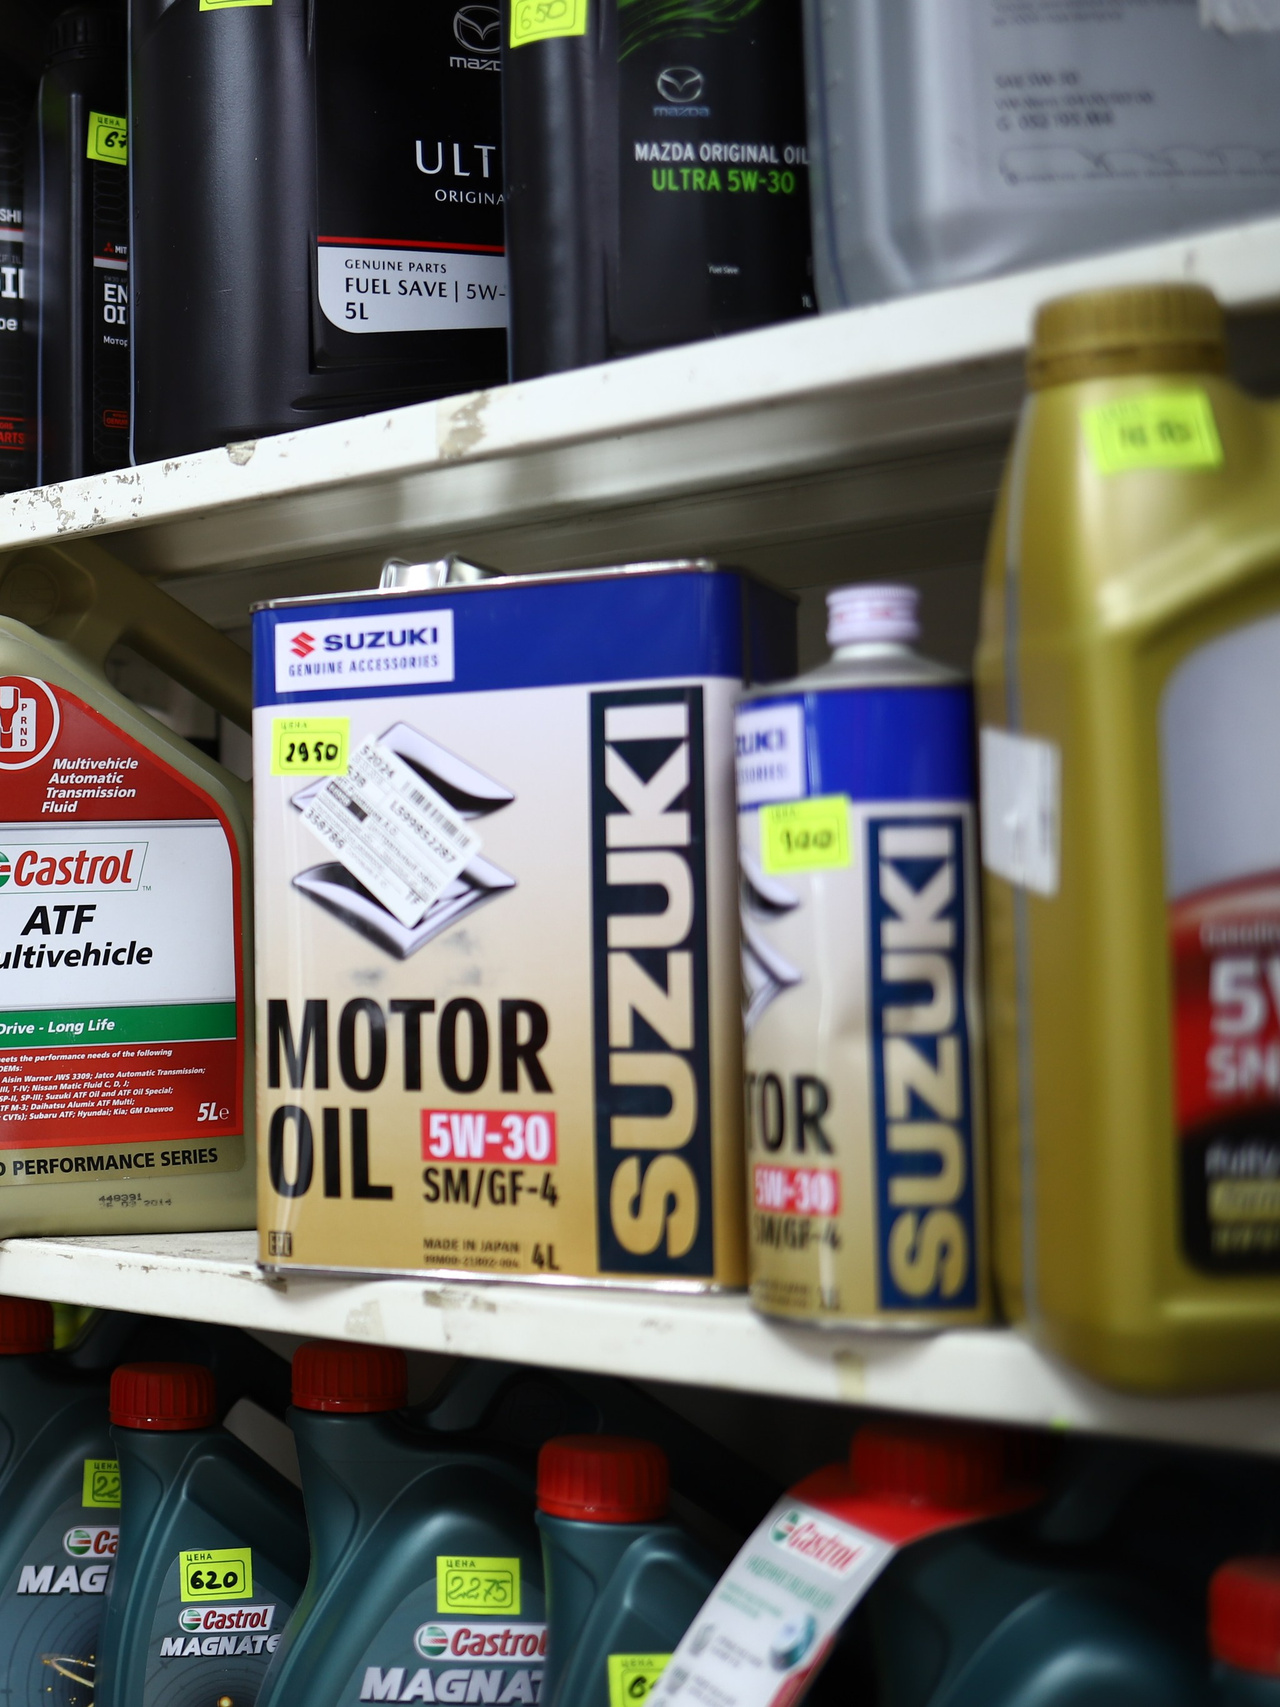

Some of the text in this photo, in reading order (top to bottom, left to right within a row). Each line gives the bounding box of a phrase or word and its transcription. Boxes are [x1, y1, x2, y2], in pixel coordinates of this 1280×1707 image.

[521, 0, 567, 30] 650
[98, 117, 120, 126] ЦЕНА
[415, 140, 496, 178] ULT
[634, 142, 810, 165] MAZDA ORIGINAL OIL
[651, 168, 795, 194] ULTRA 5W-30
[344, 259, 447, 274] GENUINE PARTS
[345, 277, 391, 296] FUEL
[398, 279, 448, 298] SAVE
[345, 302, 369, 320] 5L
[323, 627, 438, 651] SUZUKI
[288, 654, 439, 677] GENUINE ACCESSORIES
[53, 757, 138, 769] Multivehicle
[48, 772, 123, 784] Automatic
[46, 787, 136, 798] Transmission
[41, 801, 77, 813] Fluid
[14, 849, 134, 887] Castrol
[20, 904, 97, 936] ATF
[604, 702, 699, 1260] SUZUKI
[48, 1021, 84, 1035] Long
[88, 1019, 115, 1031] Life
[34, 1053, 85, 1063] performance
[87, 1051, 110, 1059] needs
[112, 1050, 120, 1058] of
[136, 1049, 172, 1057] following
[267, 998, 554, 1094] MOTOR
[878, 825, 968, 1298] SUZUKI
[116, 1070, 155, 1078] Automatic
[157, 1068, 206, 1076] Transmission;
[13, 1085, 30, 1093] T-IV;
[32, 1084, 58, 1092] Nissan
[59, 1082, 81, 1090] Matic
[83, 1081, 102, 1089] Fluid
[21, 1094, 43, 1102] SP-III;
[45, 1092, 71, 1100] Suzuki
[145, 1087, 173, 1096] Special;
[3, 1113, 27, 1121] CVTs);
[29, 1111, 57, 1120] Subaru
[77, 1109, 112, 1118] Hyundai;
[11, 1103, 28, 1111] M-3;
[31, 1102, 66, 1110] Daihatsu
[428, 1112, 552, 1161] 5W-30
[13, 1153, 155, 1176] PERFORMANCE
[160, 1147, 218, 1167] SERIES
[268, 1104, 394, 1201] OIL
[422, 1166, 560, 1208] SM/GF-4
[755, 1169, 835, 1213] 5W-30
[423, 1238, 519, 1253] MADE IN JAPAN
[531, 1242, 561, 1270] 4L
[94, 1462, 118, 1470] ЦЕНА
[787, 1520, 864, 1572] Castrol
[446, 1559, 476, 1569] ЦЕНА
[190, 1570, 238, 1589] 620
[447, 1576, 511, 1604] 2275
[203, 1609, 268, 1630] Castrol
